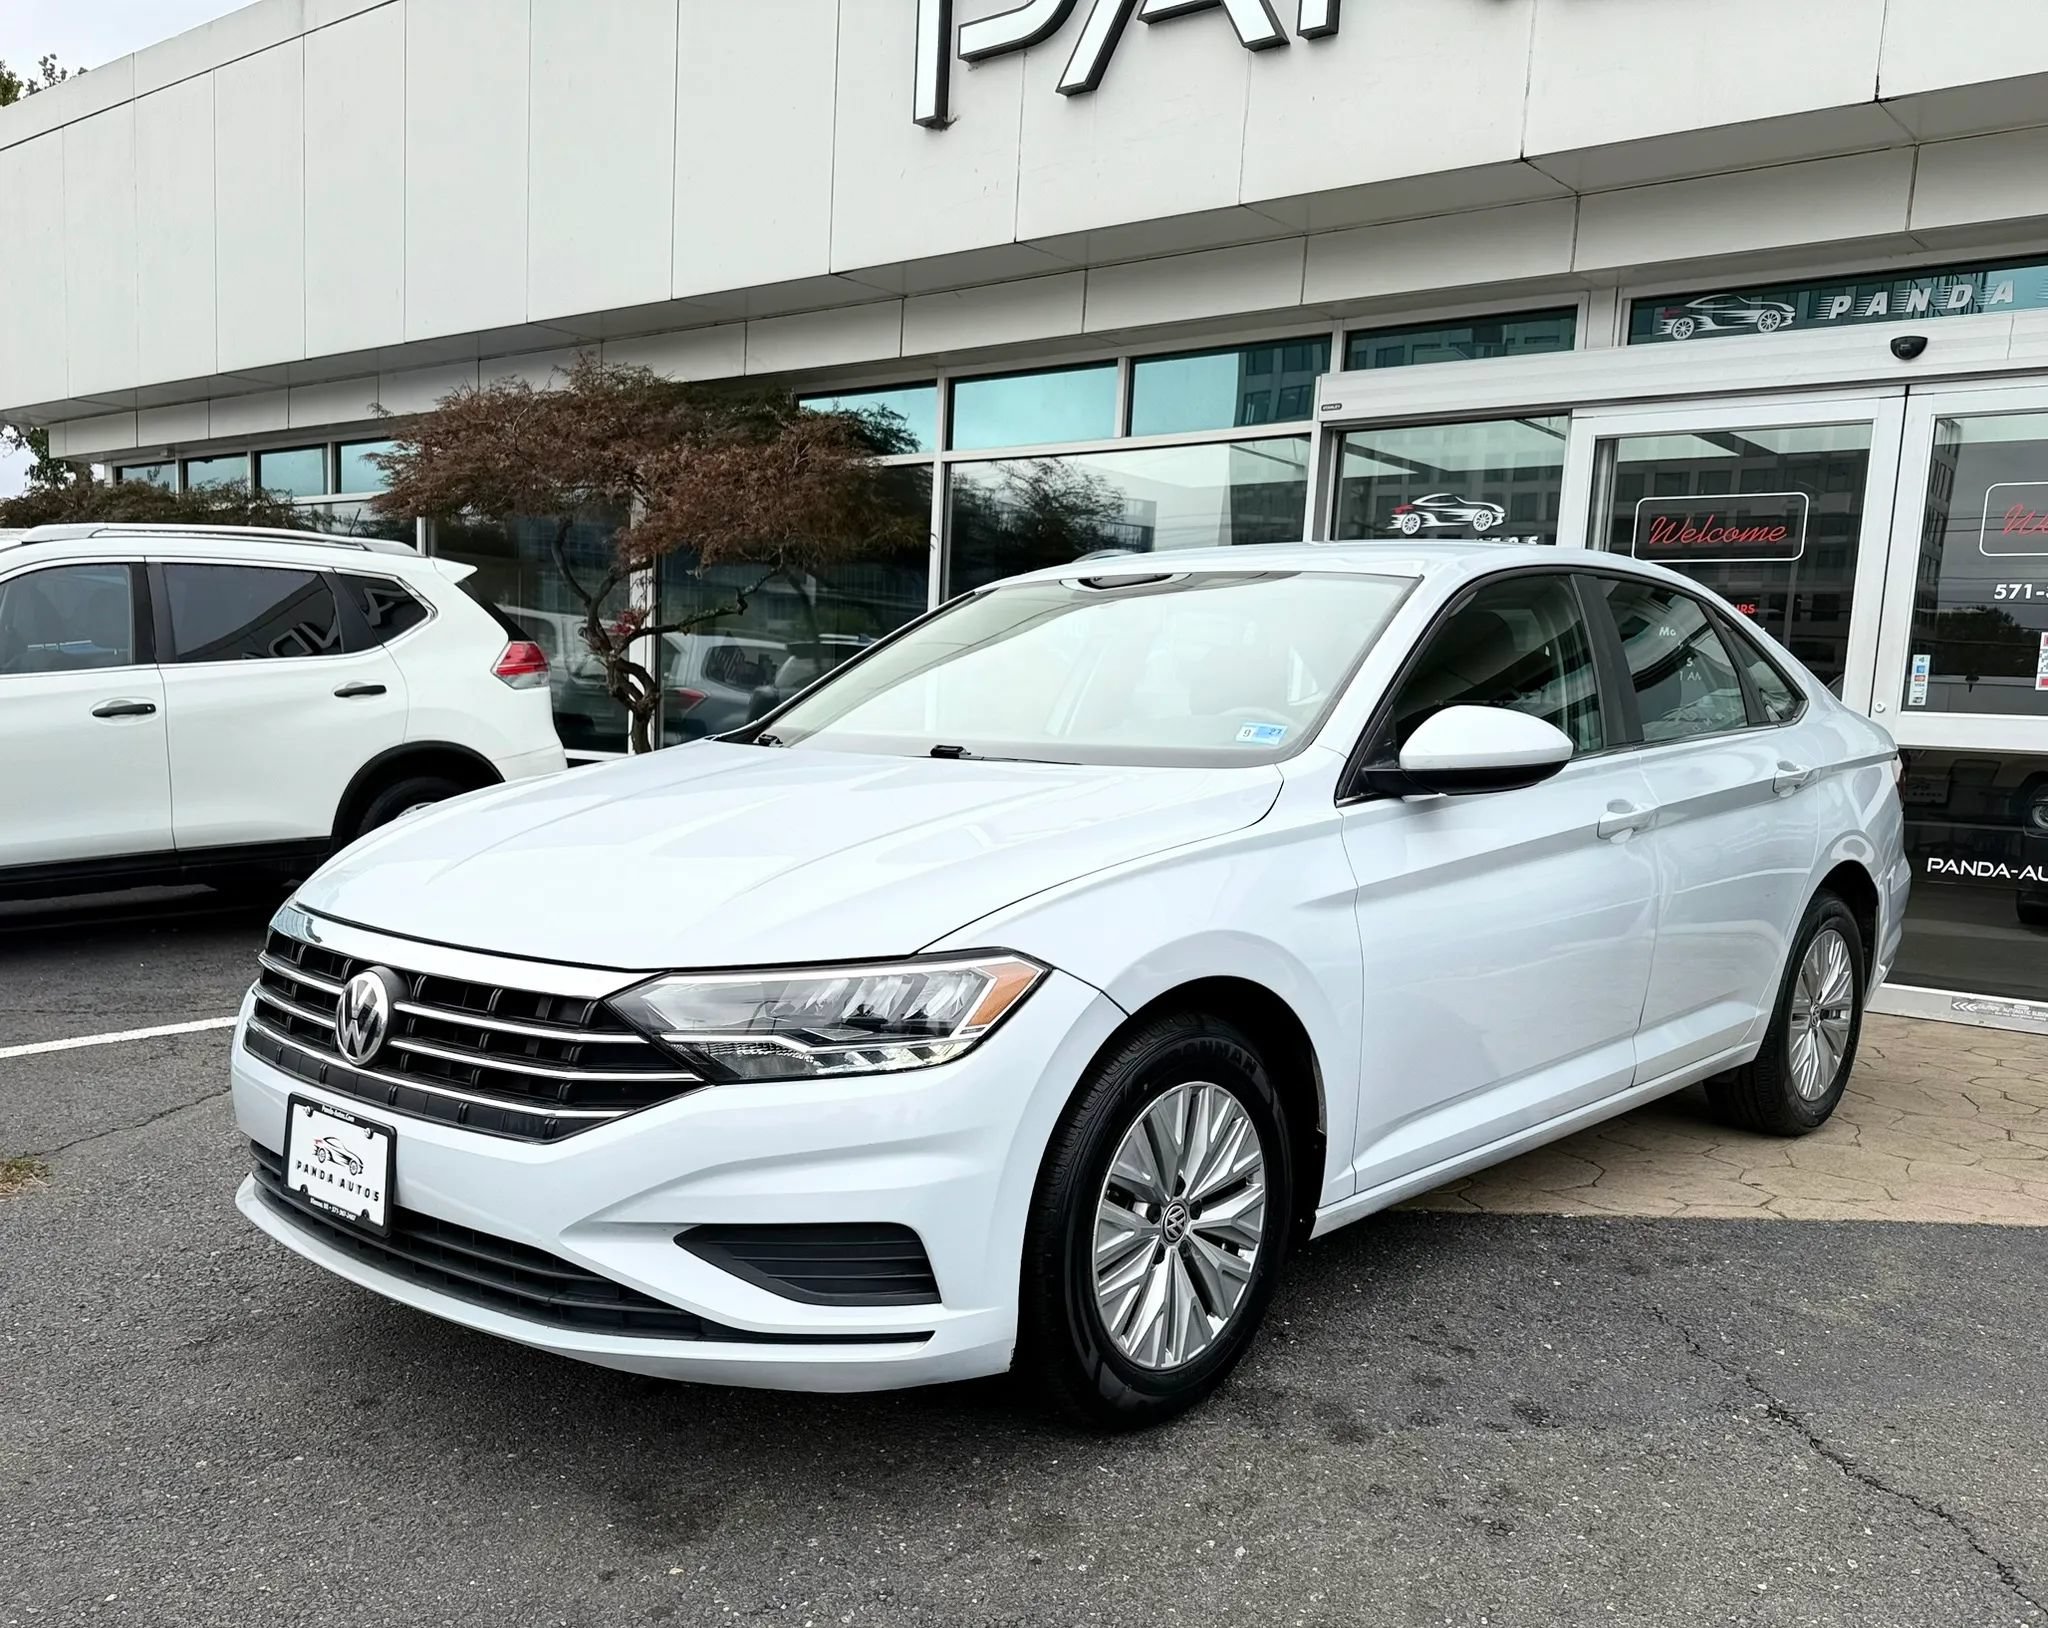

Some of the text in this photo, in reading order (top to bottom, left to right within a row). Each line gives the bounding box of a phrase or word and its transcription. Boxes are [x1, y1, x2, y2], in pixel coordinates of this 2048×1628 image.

[1817, 280, 2014, 320] PANDA
[1650, 513, 1787, 545] Welcome
[296, 1160, 380, 1202] PANDA AUTOS
